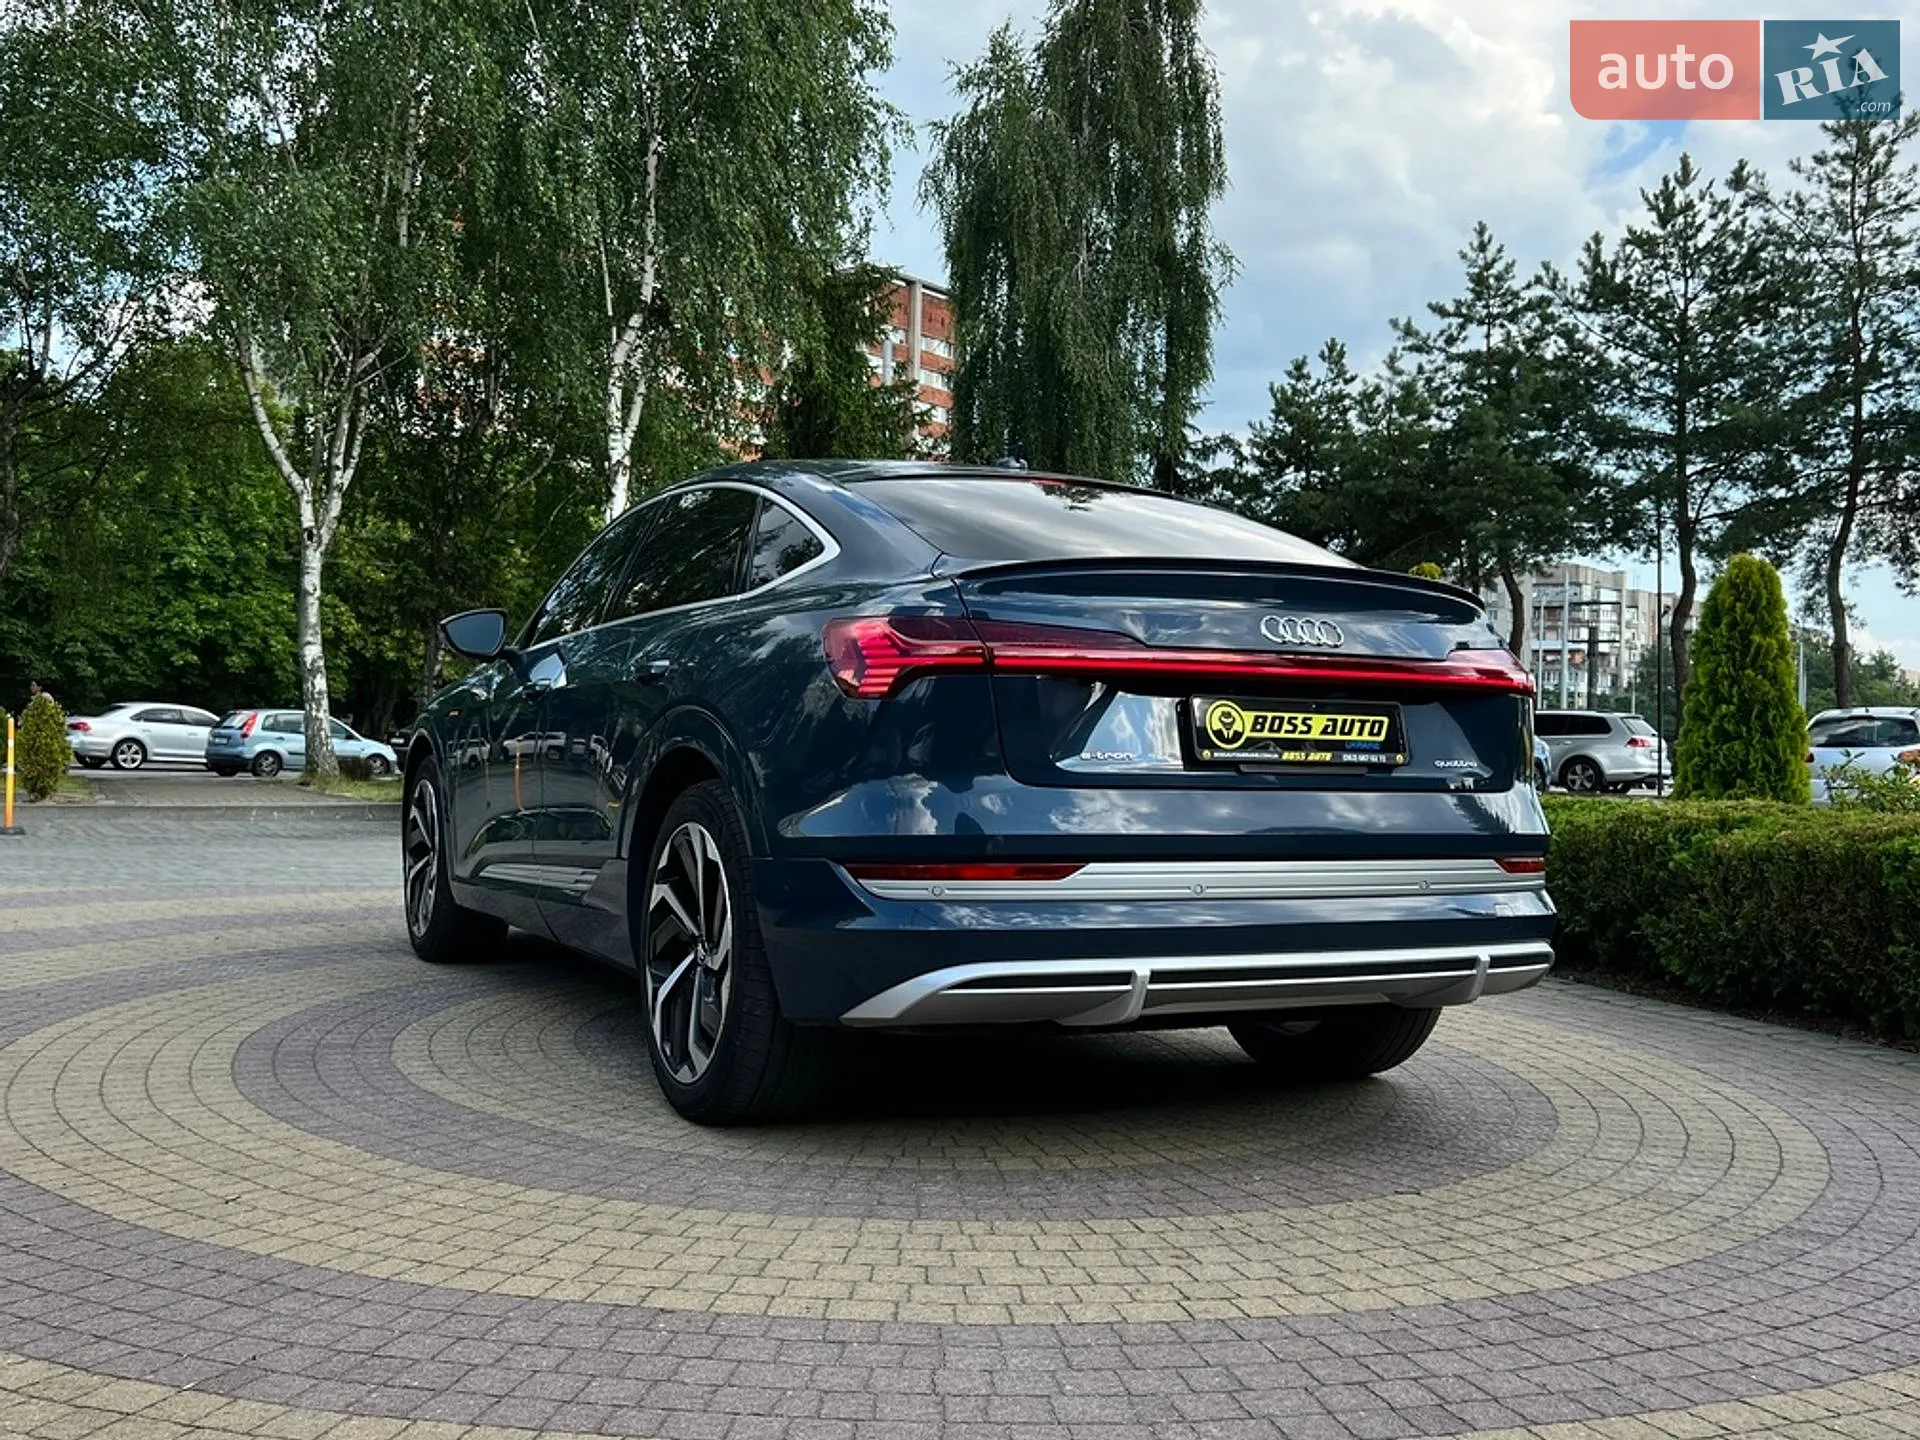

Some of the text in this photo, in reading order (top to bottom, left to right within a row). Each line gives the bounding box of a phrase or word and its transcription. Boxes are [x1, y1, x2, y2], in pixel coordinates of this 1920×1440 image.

[1250, 714, 1386, 737] BOSS AUTO
[1434, 760, 1478, 768] quattro
